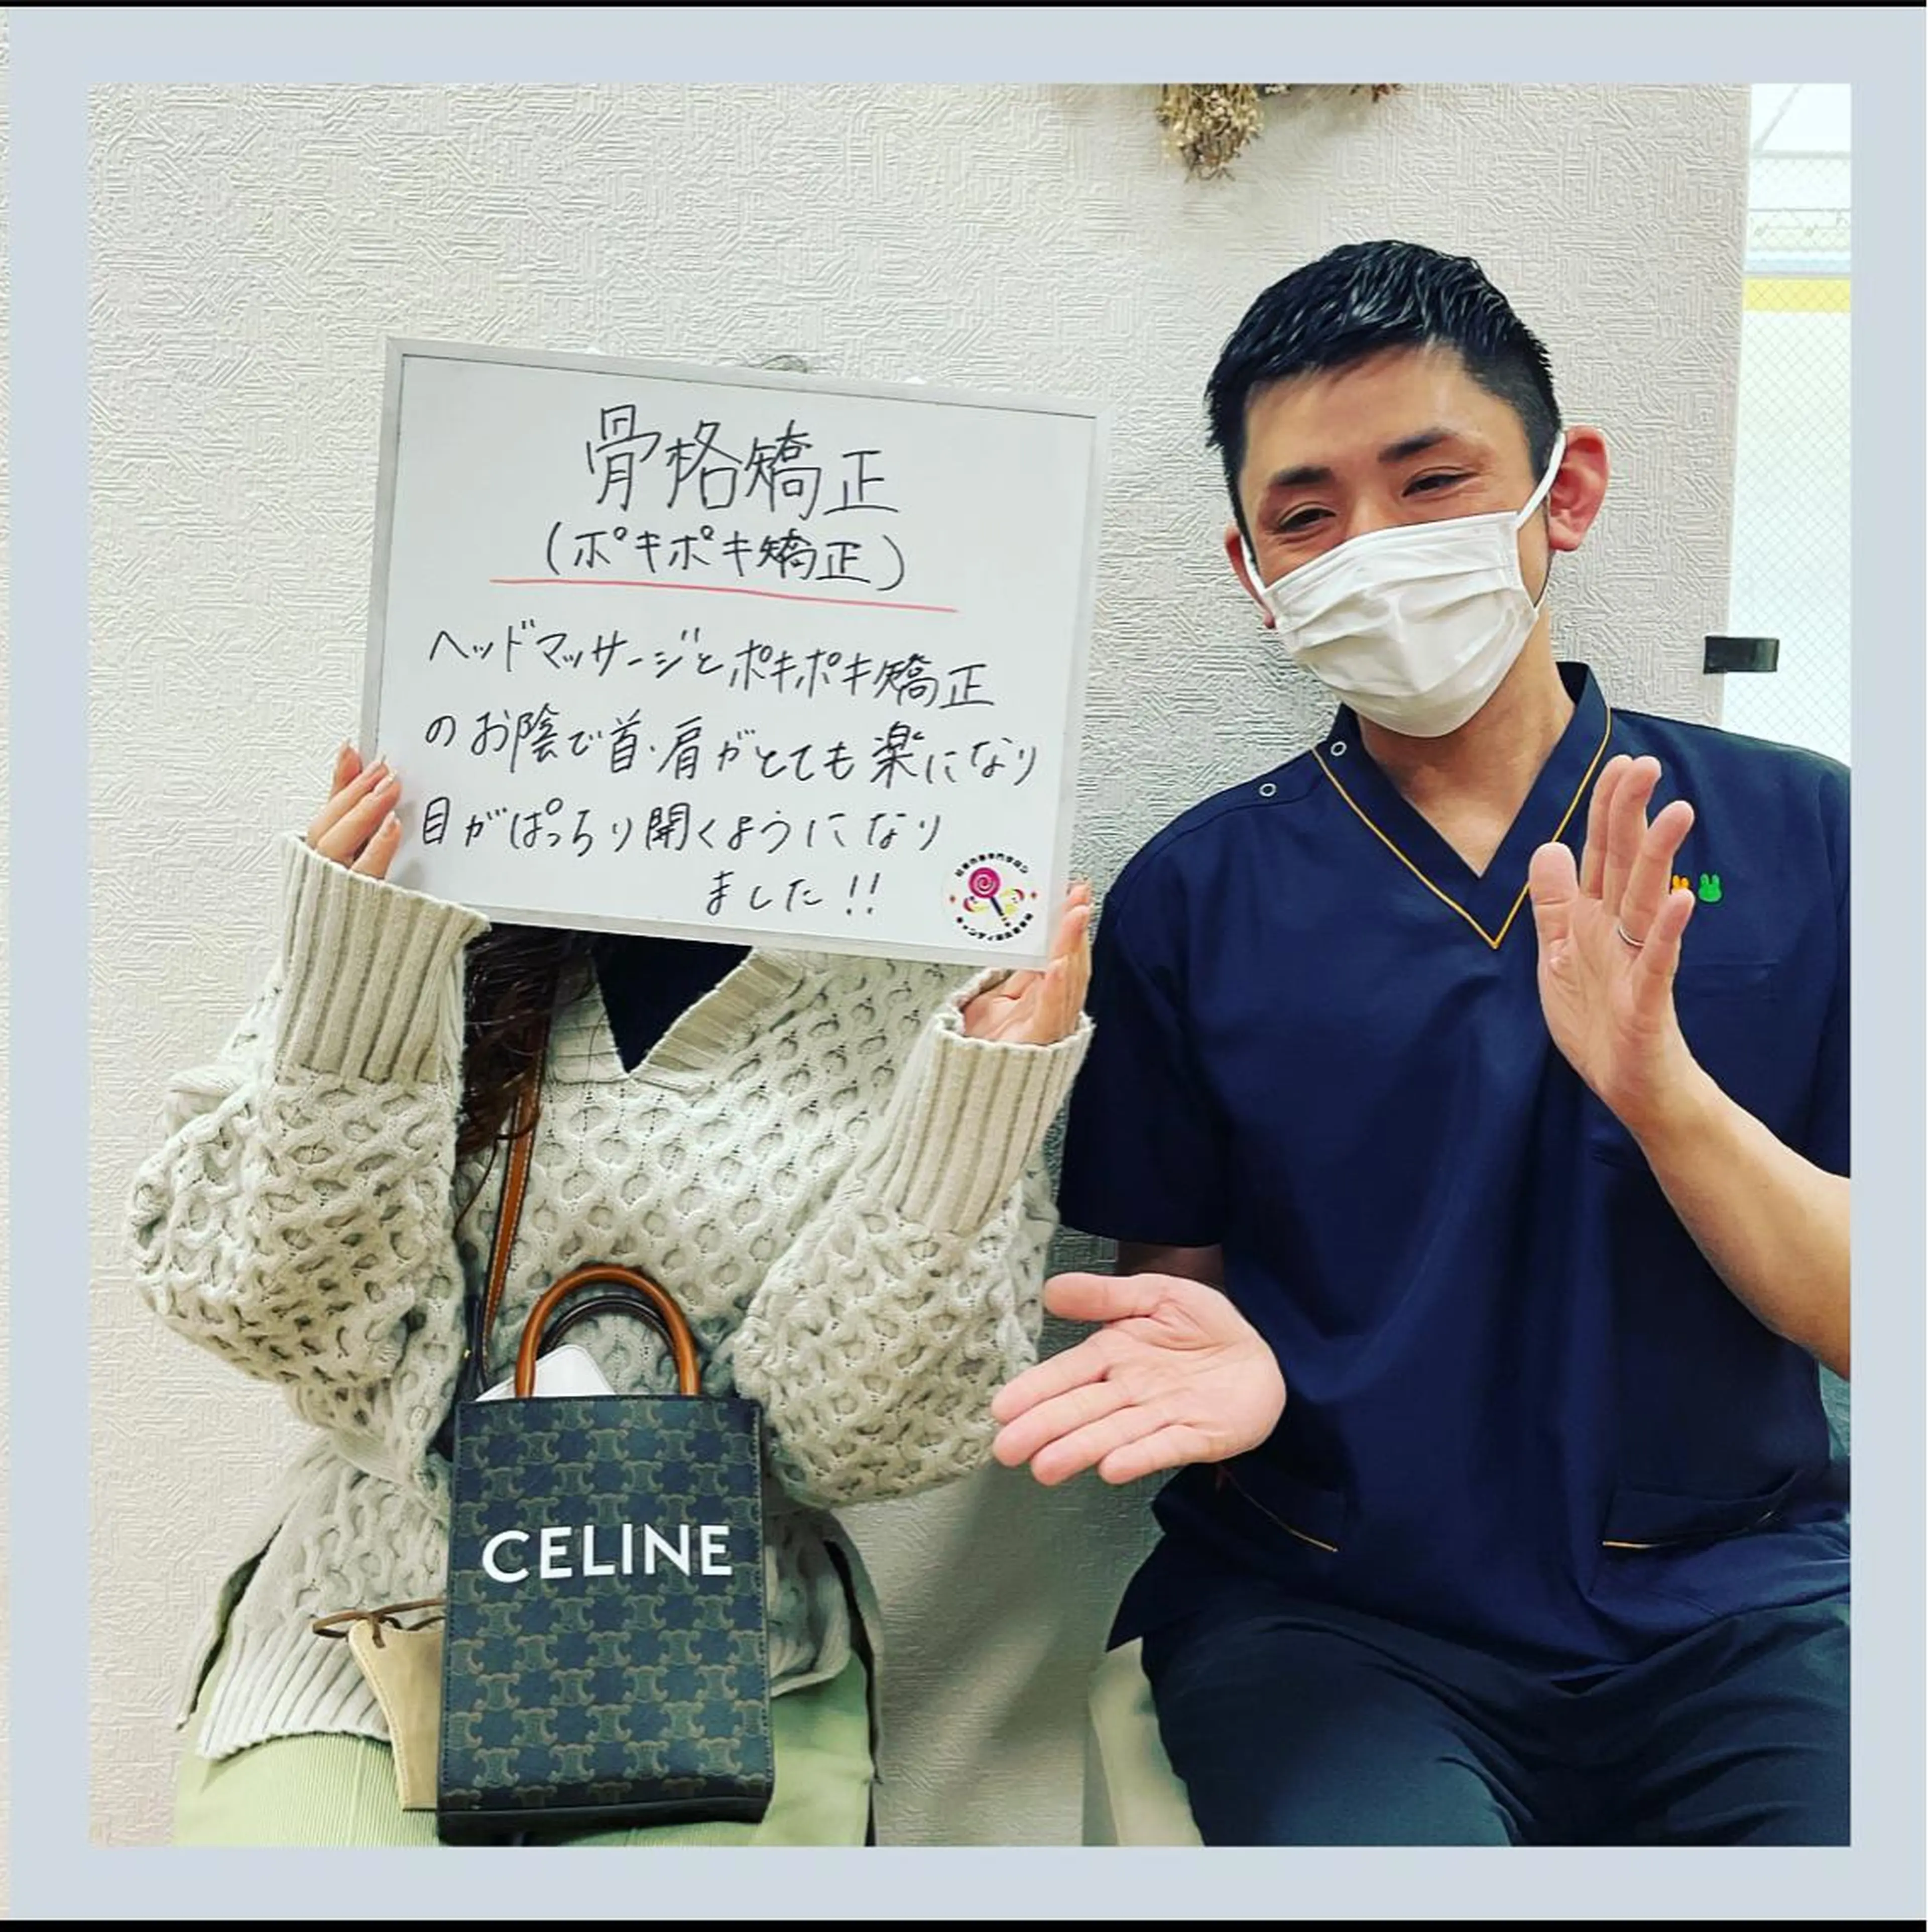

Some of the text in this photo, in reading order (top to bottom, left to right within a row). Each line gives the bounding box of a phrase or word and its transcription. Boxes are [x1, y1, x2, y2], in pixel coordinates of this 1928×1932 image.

[585, 403, 900, 521] 骨格矯正
[429, 618, 995, 710] ヘッドマッサージとポキポキ矯正
[422, 797, 941, 858] 目がぱっちり開くようになり
[482, 1523, 733, 1583] CELINE
